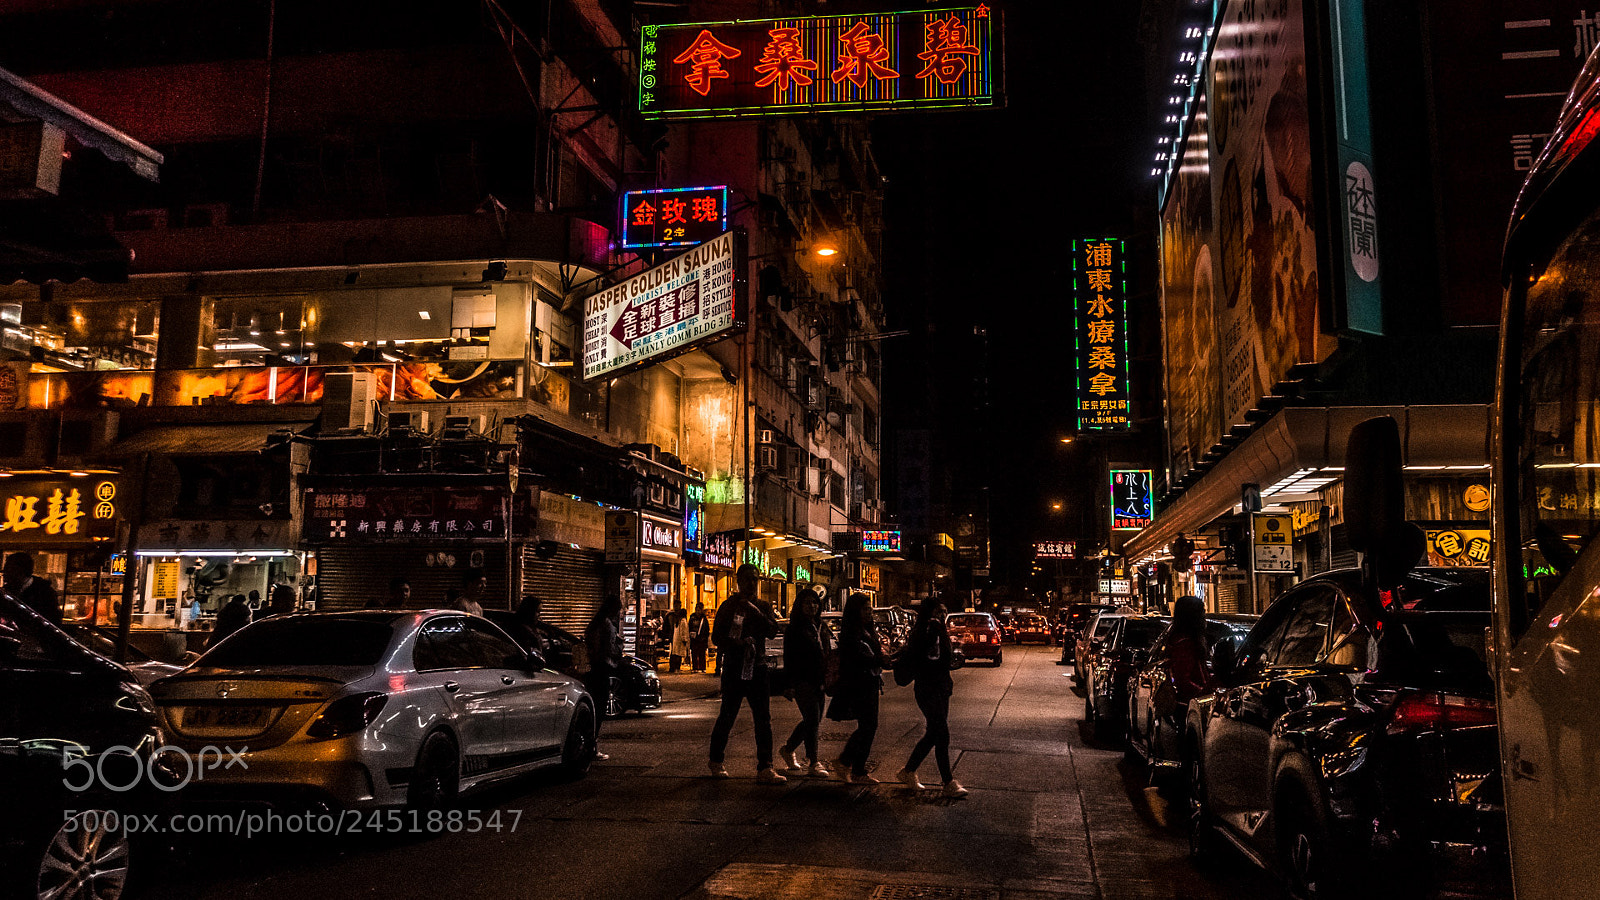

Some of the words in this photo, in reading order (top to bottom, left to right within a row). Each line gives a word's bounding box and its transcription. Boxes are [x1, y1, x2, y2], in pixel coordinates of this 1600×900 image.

[632, 196, 718, 226] 金玫瑰
[587, 286, 628, 316] JASPER
[631, 260, 680, 298] GOLDEN
[684, 237, 731, 274] SAUNA
[711, 258, 732, 276] HONG
[633, 287, 663, 306] TOURIST
[667, 270, 700, 291] WELCOME
[711, 272, 732, 289] KONG
[623, 283, 697, 326] 全新裝修
[711, 286, 732, 304] STYLE
[711, 300, 732, 318] SERVICE
[1085, 242, 1117, 397] 浦東水療桑拿
[585, 315, 600, 330] MOST
[585, 328, 600, 342] CHEAP
[623, 302, 697, 343] 足球直播
[638, 339, 665, 357] MANLY
[667, 329, 692, 346] COMM
[694, 318, 716, 337] BLDG
[585, 352, 600, 365] ONLY
[1124, 472, 1139, 515] 水上人
[653, 526, 673, 547] Circle
[673, 530, 680, 548] K
